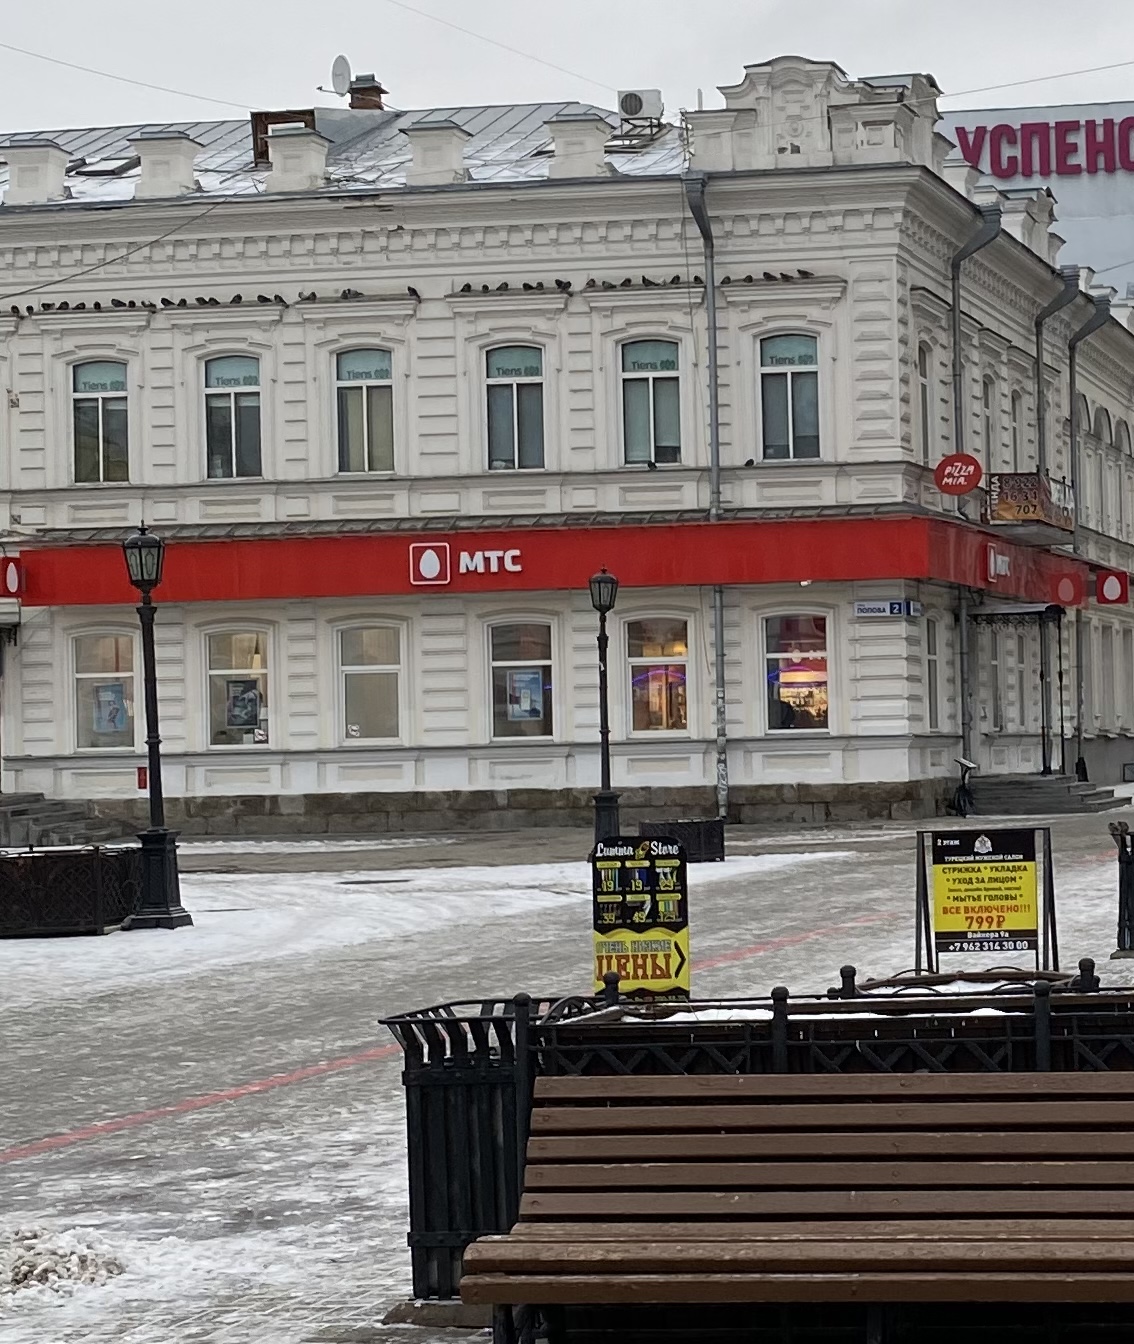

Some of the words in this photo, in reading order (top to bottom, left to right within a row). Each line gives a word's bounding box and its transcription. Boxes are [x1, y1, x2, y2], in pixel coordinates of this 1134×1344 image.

[632, 360, 657, 370] Tiens
[770, 355, 795, 365] Tiens
[346, 370, 372, 379] Tiens
[496, 366, 522, 376] Tiens
[82, 381, 108, 390] Tiens
[215, 376, 240, 386] Tiens
[944, 462, 975, 477] PIZZA
[1015, 504, 1038, 515] 707
[459, 549, 522, 574] МТС
[893, 604, 900, 614] 2
[650, 841, 679, 855] Store
[942, 866, 982, 874] СТРИЖКА
[989, 865, 1028, 873] УКЛАДКА
[952, 877, 973, 885] УХОД
[975, 876, 985, 884] ЗА
[987, 876, 1017, 884] ЛИЦОМ
[953, 894, 982, 902] МЫТЬЕ
[984, 893, 1018, 902] ГОЛОВЫ
[942, 906, 962, 915] ВСЕ
[964, 904, 1031, 915] ВКЛЮЧЕНО!!!
[948, 942, 961, 951] +7
[963, 942, 980, 951] 962
[1002, 941, 1015, 950] 30
[1016, 940, 1029, 949] 00
[596, 953, 672, 981] ЦЕНЫ
